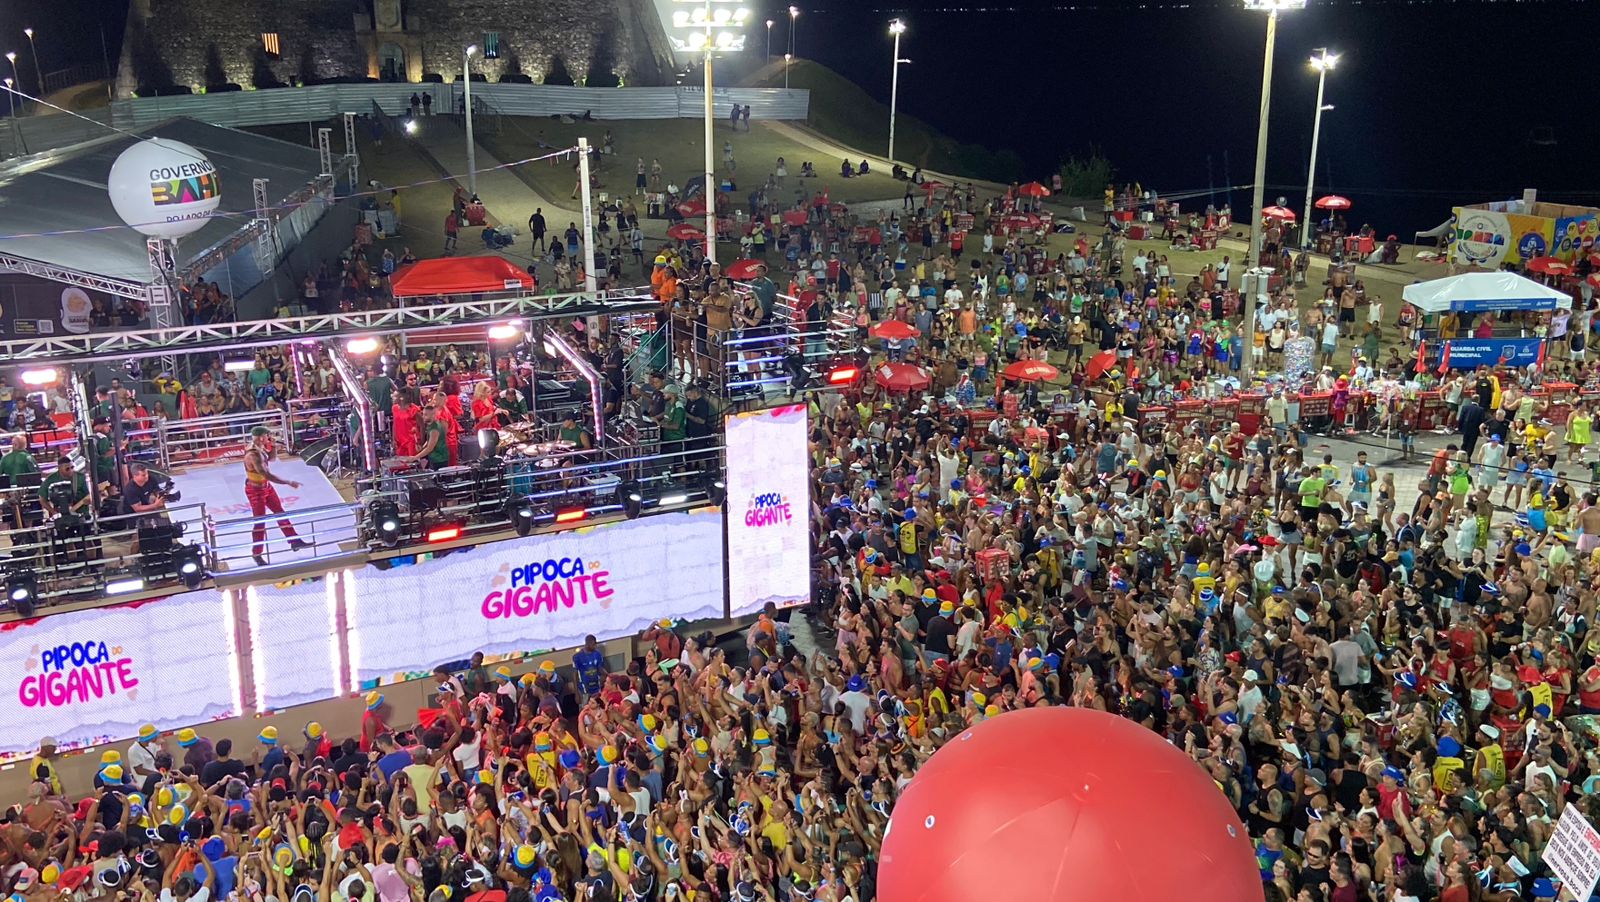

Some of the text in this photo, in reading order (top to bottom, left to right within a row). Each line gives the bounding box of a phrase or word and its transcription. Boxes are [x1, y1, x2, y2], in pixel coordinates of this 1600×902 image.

[150, 160, 212, 181] GOVERNO
[745, 503, 792, 527] GIGANTE
[754, 492, 781, 509] PIPOCA
[511, 557, 584, 588] PIPOCA
[481, 571, 614, 619] GIGANTE
[42, 641, 109, 673] PIPOCA
[19, 658, 139, 707] GIGANTE
